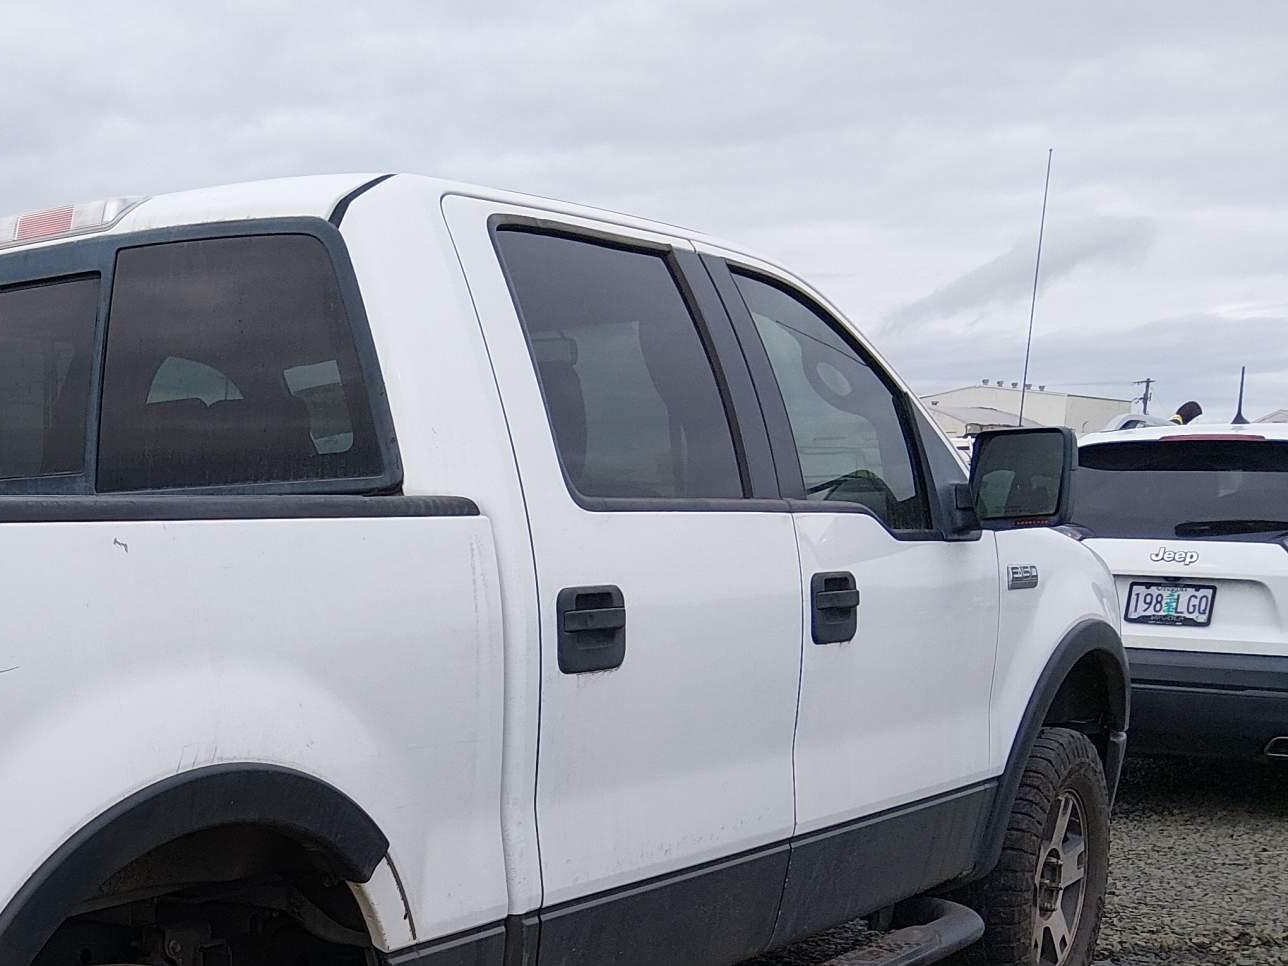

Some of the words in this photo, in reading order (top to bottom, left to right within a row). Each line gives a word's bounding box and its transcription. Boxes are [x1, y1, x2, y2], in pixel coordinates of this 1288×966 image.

[1150, 547, 1199, 565] Jeep
[1133, 592, 1164, 613] 198
[1174, 593, 1209, 615] LGQ
